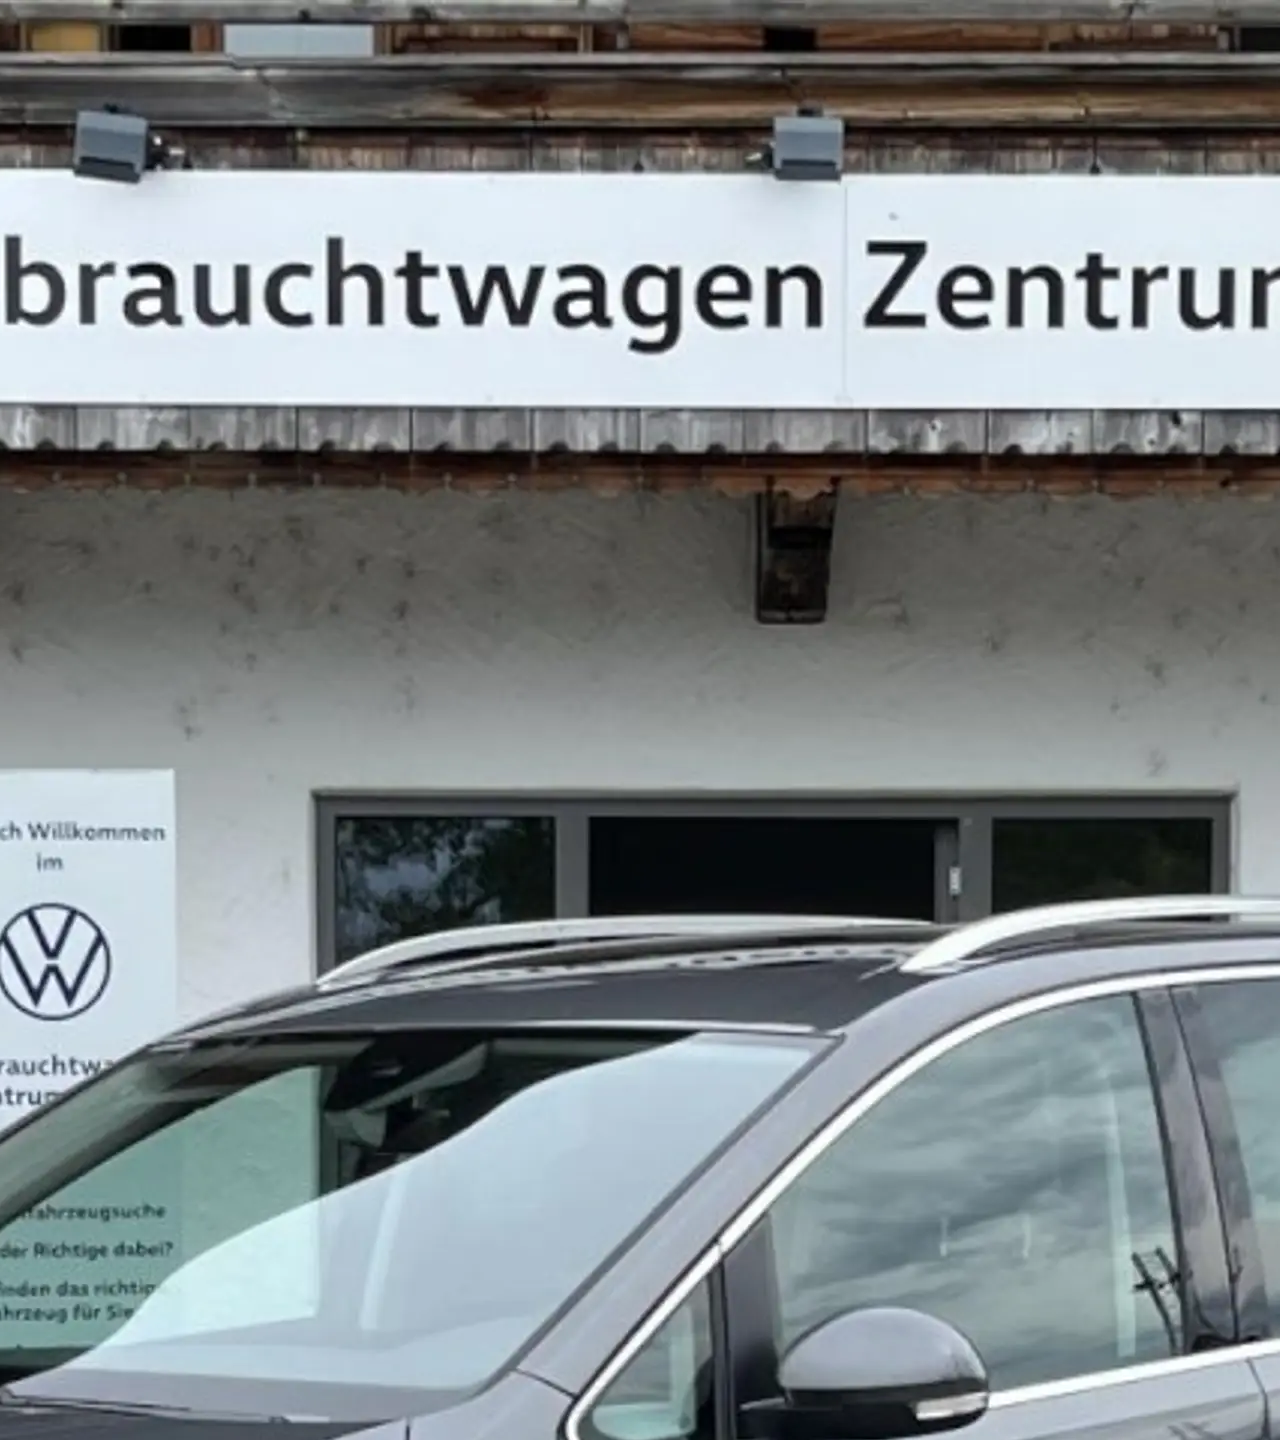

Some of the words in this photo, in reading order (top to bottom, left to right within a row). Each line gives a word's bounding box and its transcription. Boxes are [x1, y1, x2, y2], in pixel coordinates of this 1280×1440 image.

[28, 820, 167, 842] Willkommen
[36, 853, 64, 872] im
[22, 1203, 166, 1222] ahrzeugsuche
[33, 1240, 109, 1262] Richtige
[112, 1239, 175, 1258] dabei?
[56, 1278, 89, 1297] das
[72, 1303, 102, 1321] für
